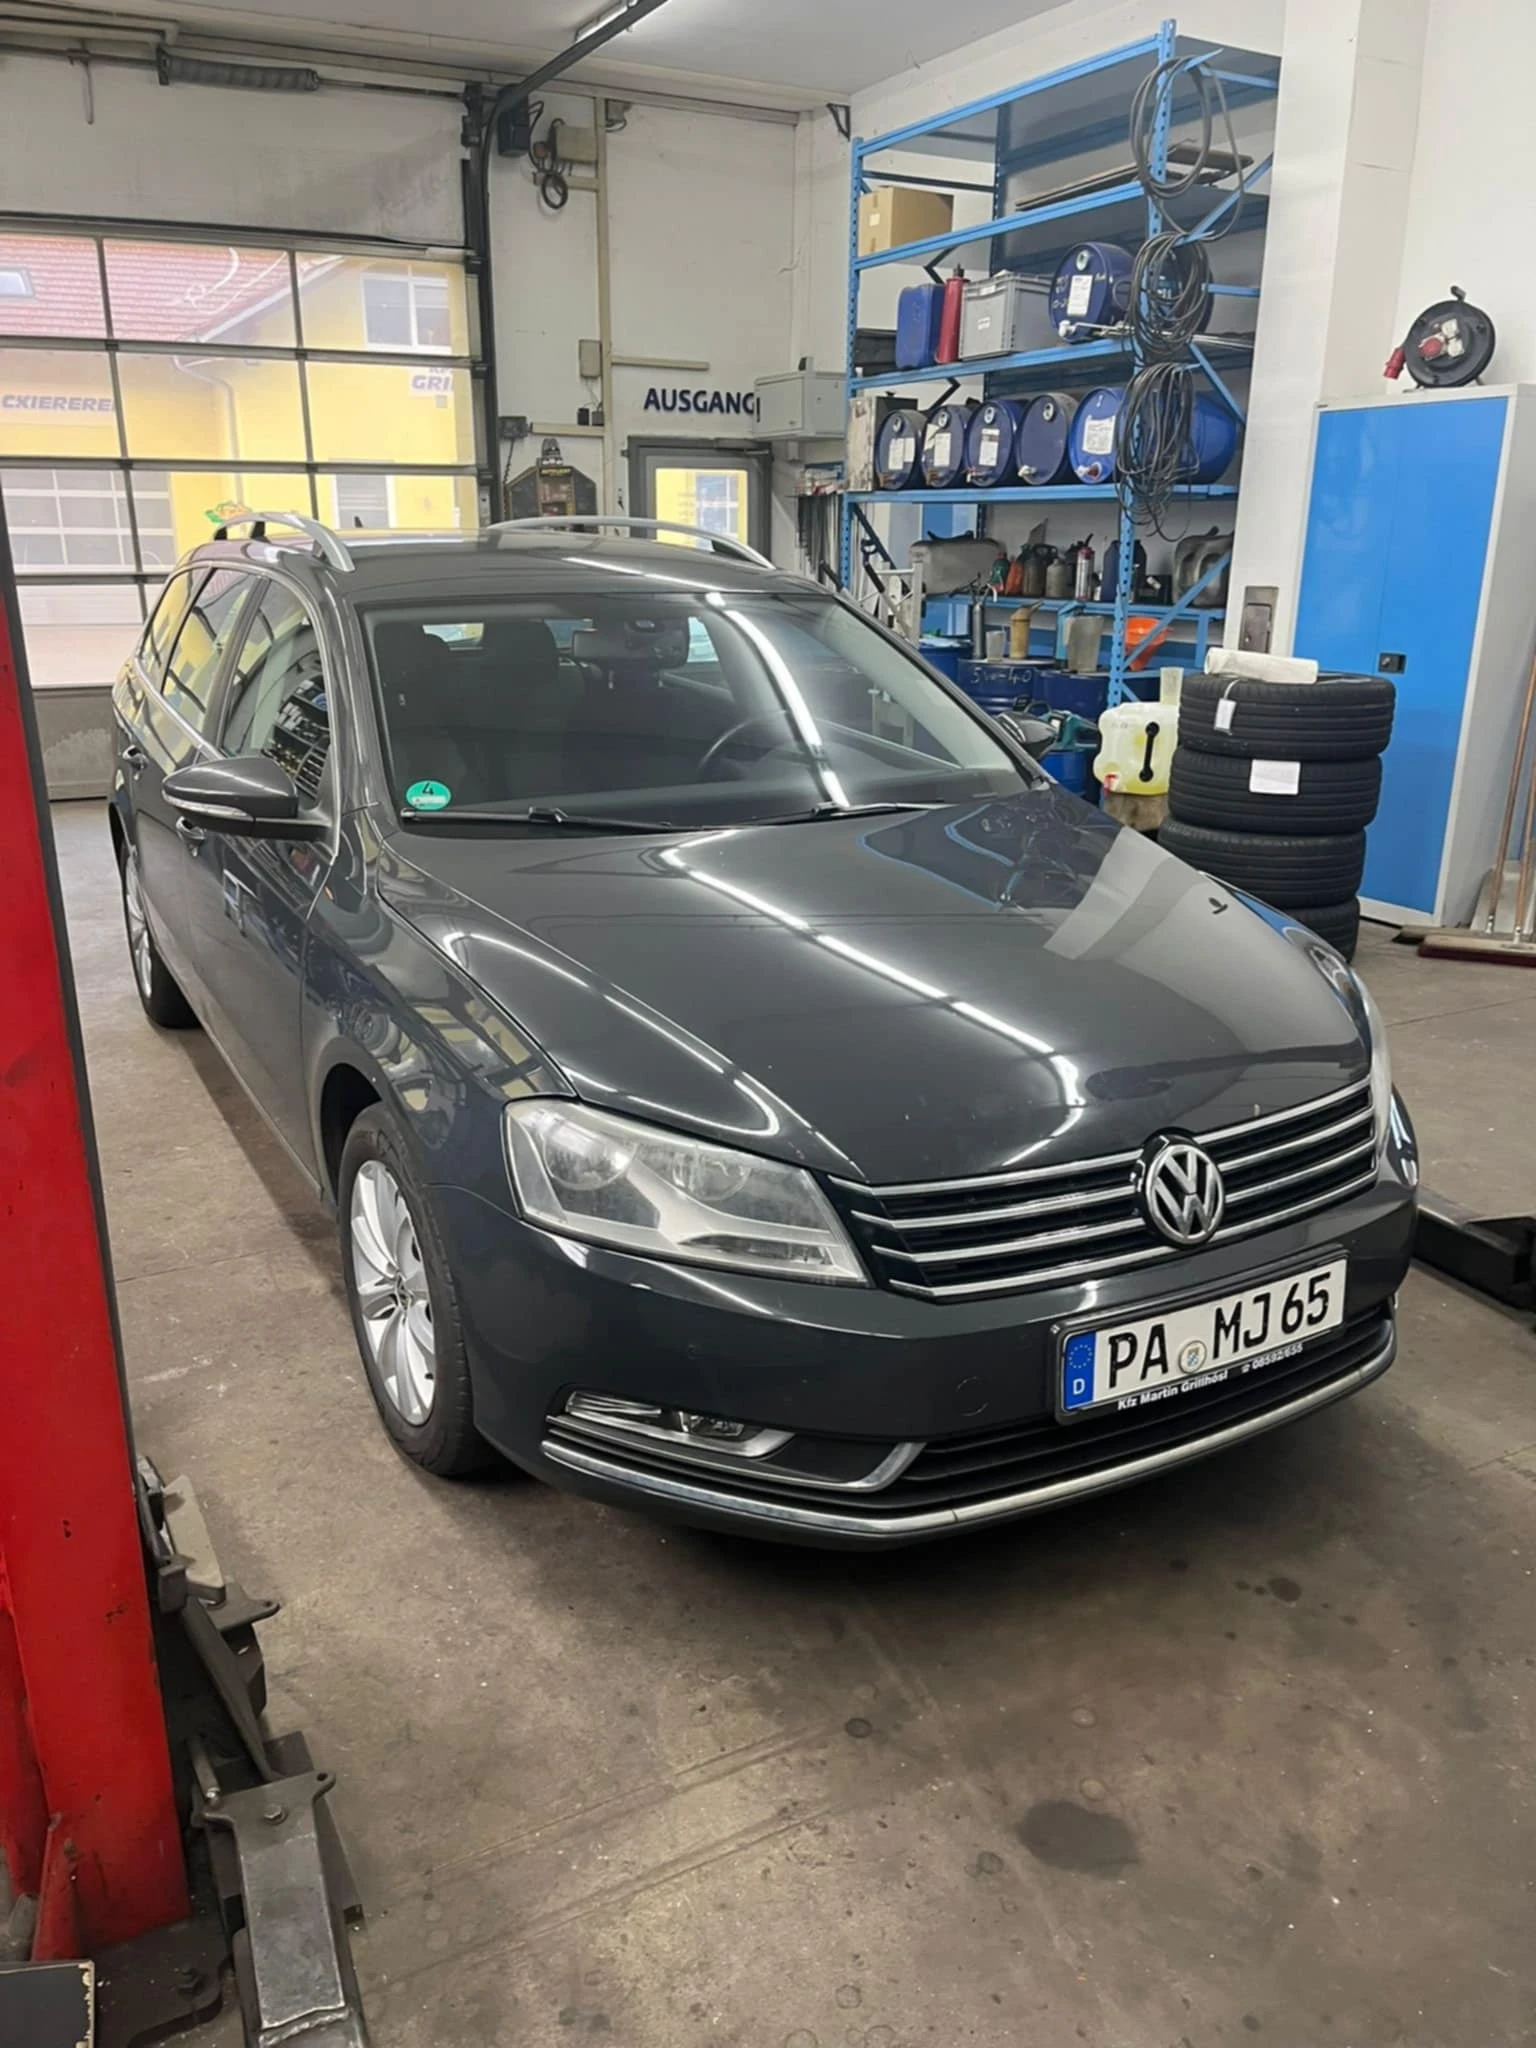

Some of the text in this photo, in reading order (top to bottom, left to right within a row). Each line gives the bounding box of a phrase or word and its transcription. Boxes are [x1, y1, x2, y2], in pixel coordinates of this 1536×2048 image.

[422, 782, 434, 795] 4
[1108, 1323, 1169, 1389] PA
[1072, 1378, 1086, 1395] D
[1118, 1397, 1137, 1410] Kfz
[1140, 1386, 1178, 1404] Martin
